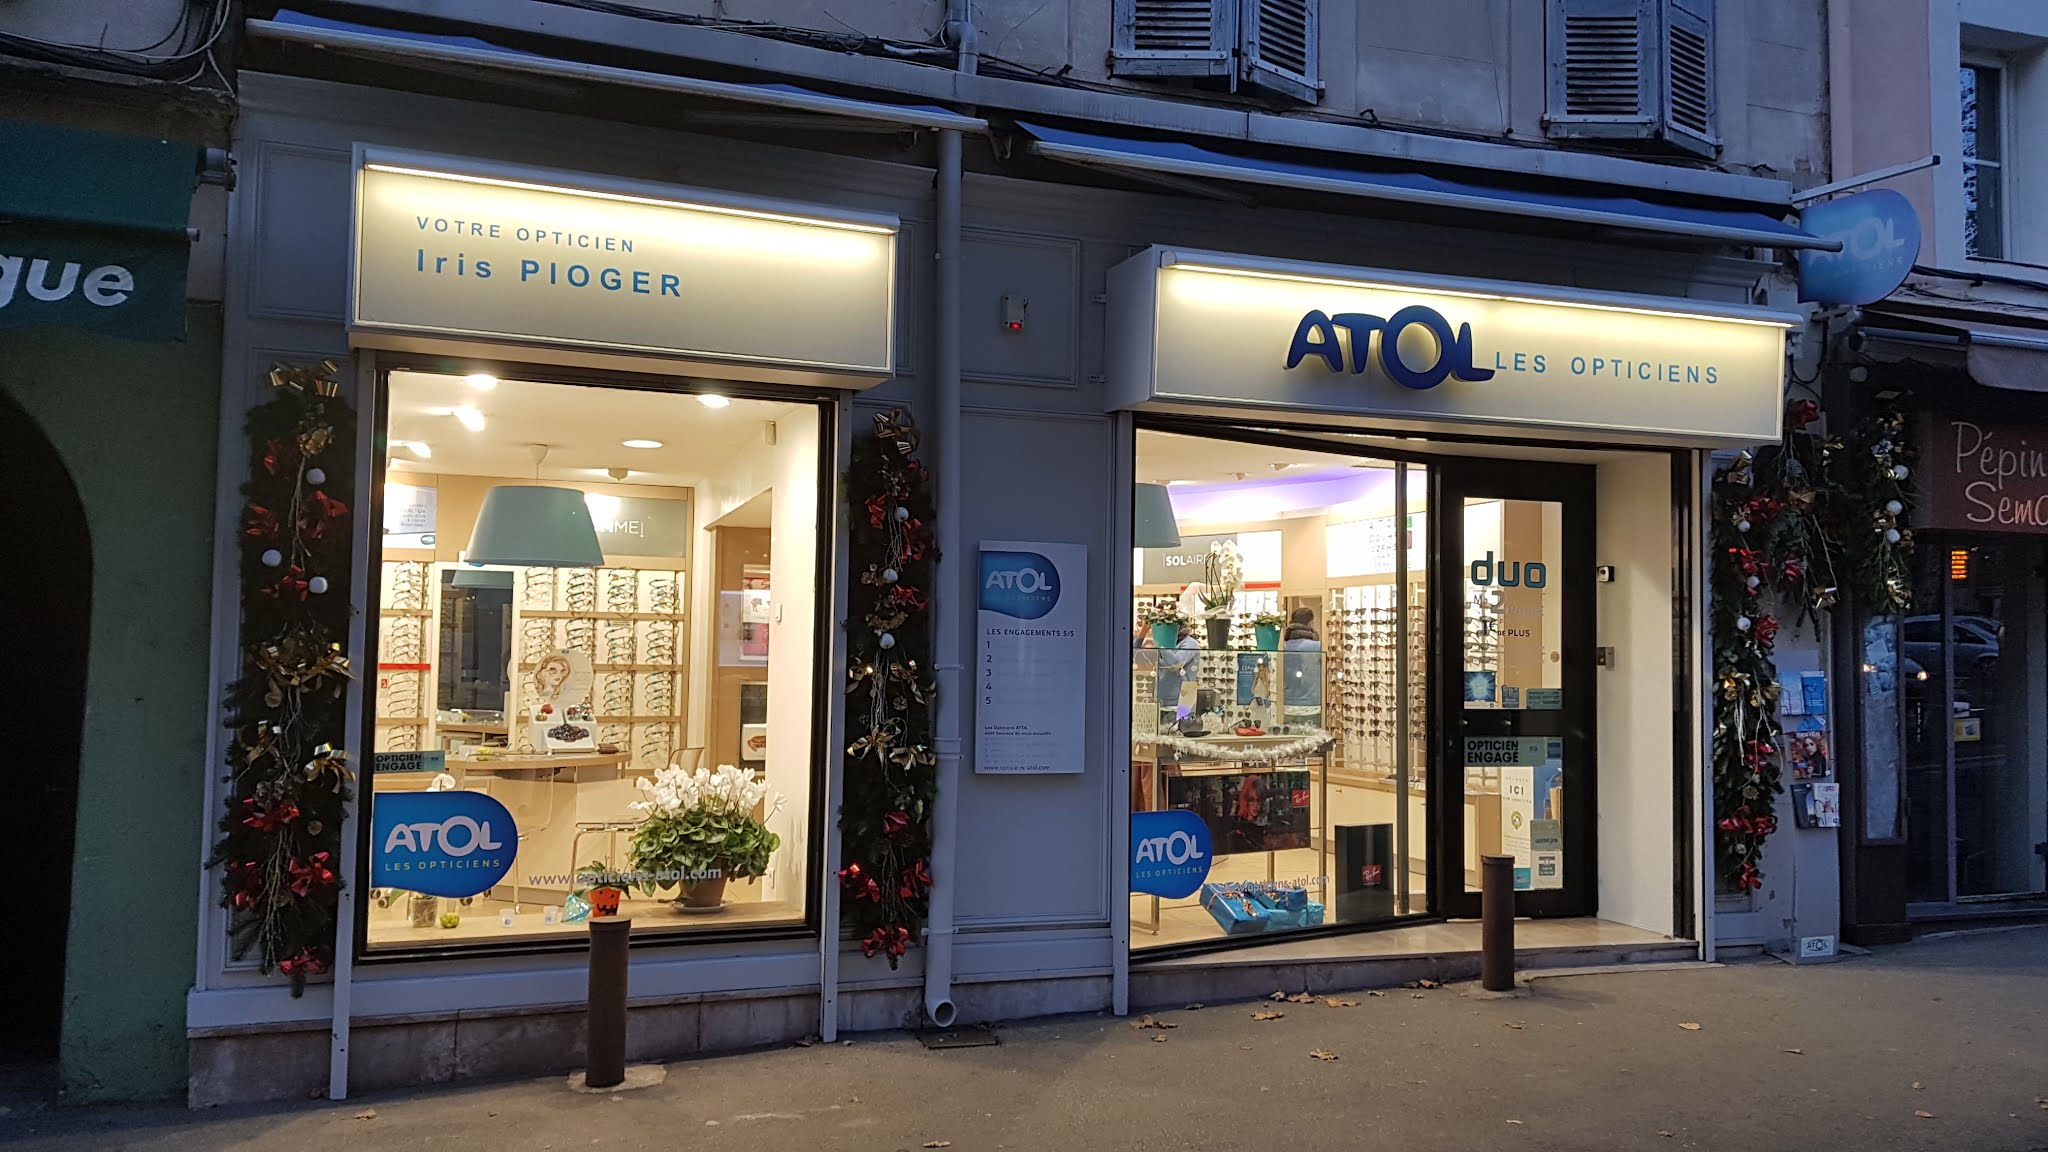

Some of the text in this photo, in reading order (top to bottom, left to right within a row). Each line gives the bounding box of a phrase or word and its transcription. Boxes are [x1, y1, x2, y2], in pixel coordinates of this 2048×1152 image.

[416, 216, 634, 253] VOTRE OPTICIEN
[417, 249, 681, 297] Iris PIOGER
[1283, 305, 1720, 390] ATOL LES OPTICIENS
[1471, 551, 1547, 588] duo
[985, 567, 1053, 594] ATOL
[986, 628, 1001, 636] LES
[1004, 628, 1061, 637] ENGAGEMENTS
[1508, 628, 1531, 637] PLUS
[985, 640, 991, 649] 1
[985, 654, 992, 663] 2
[985, 668, 992, 677] 3
[985, 682, 992, 691] 4
[985, 696, 992, 705] 5
[1467, 740, 1519, 751] OPTICIEN
[376, 753, 422, 763] OPTICIEN
[1509, 785, 1524, 796] ICI
[384, 815, 503, 857] ATOL
[1135, 830, 1204, 866] ATOL
[385, 859, 500, 872] LES OPTICIENS
[1135, 866, 1204, 879] LES OPTICIENS
